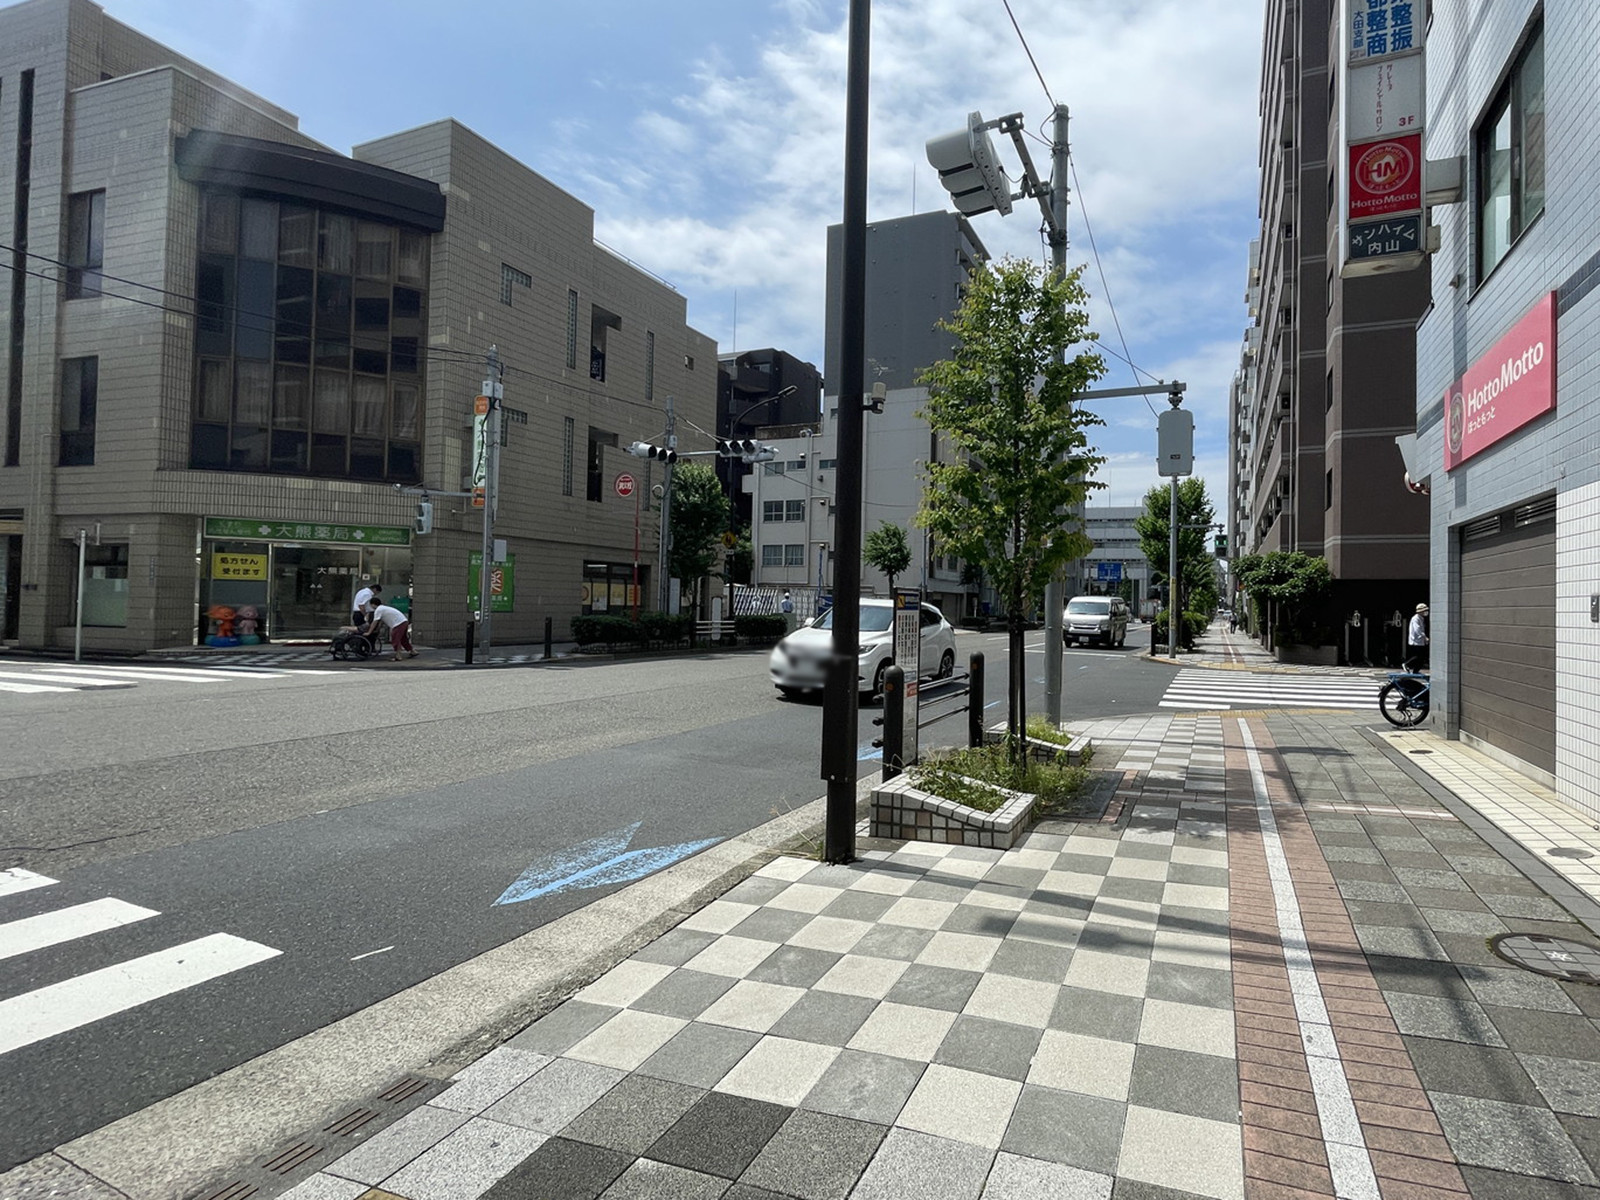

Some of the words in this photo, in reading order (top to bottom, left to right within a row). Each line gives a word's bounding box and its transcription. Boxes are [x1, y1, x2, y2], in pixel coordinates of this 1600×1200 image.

[1391, 0, 1412, 51] 整振
[1399, 115, 1415, 127] 3F
[1352, 224, 1415, 247] サンハイム
[1368, 240, 1400, 255] 内山
[1467, 405, 1496, 434] ほっともっと
[275, 524, 350, 540] 大熊薬局
[220, 556, 259, 566] 処方せん
[222, 567, 260, 576] 受付ます
